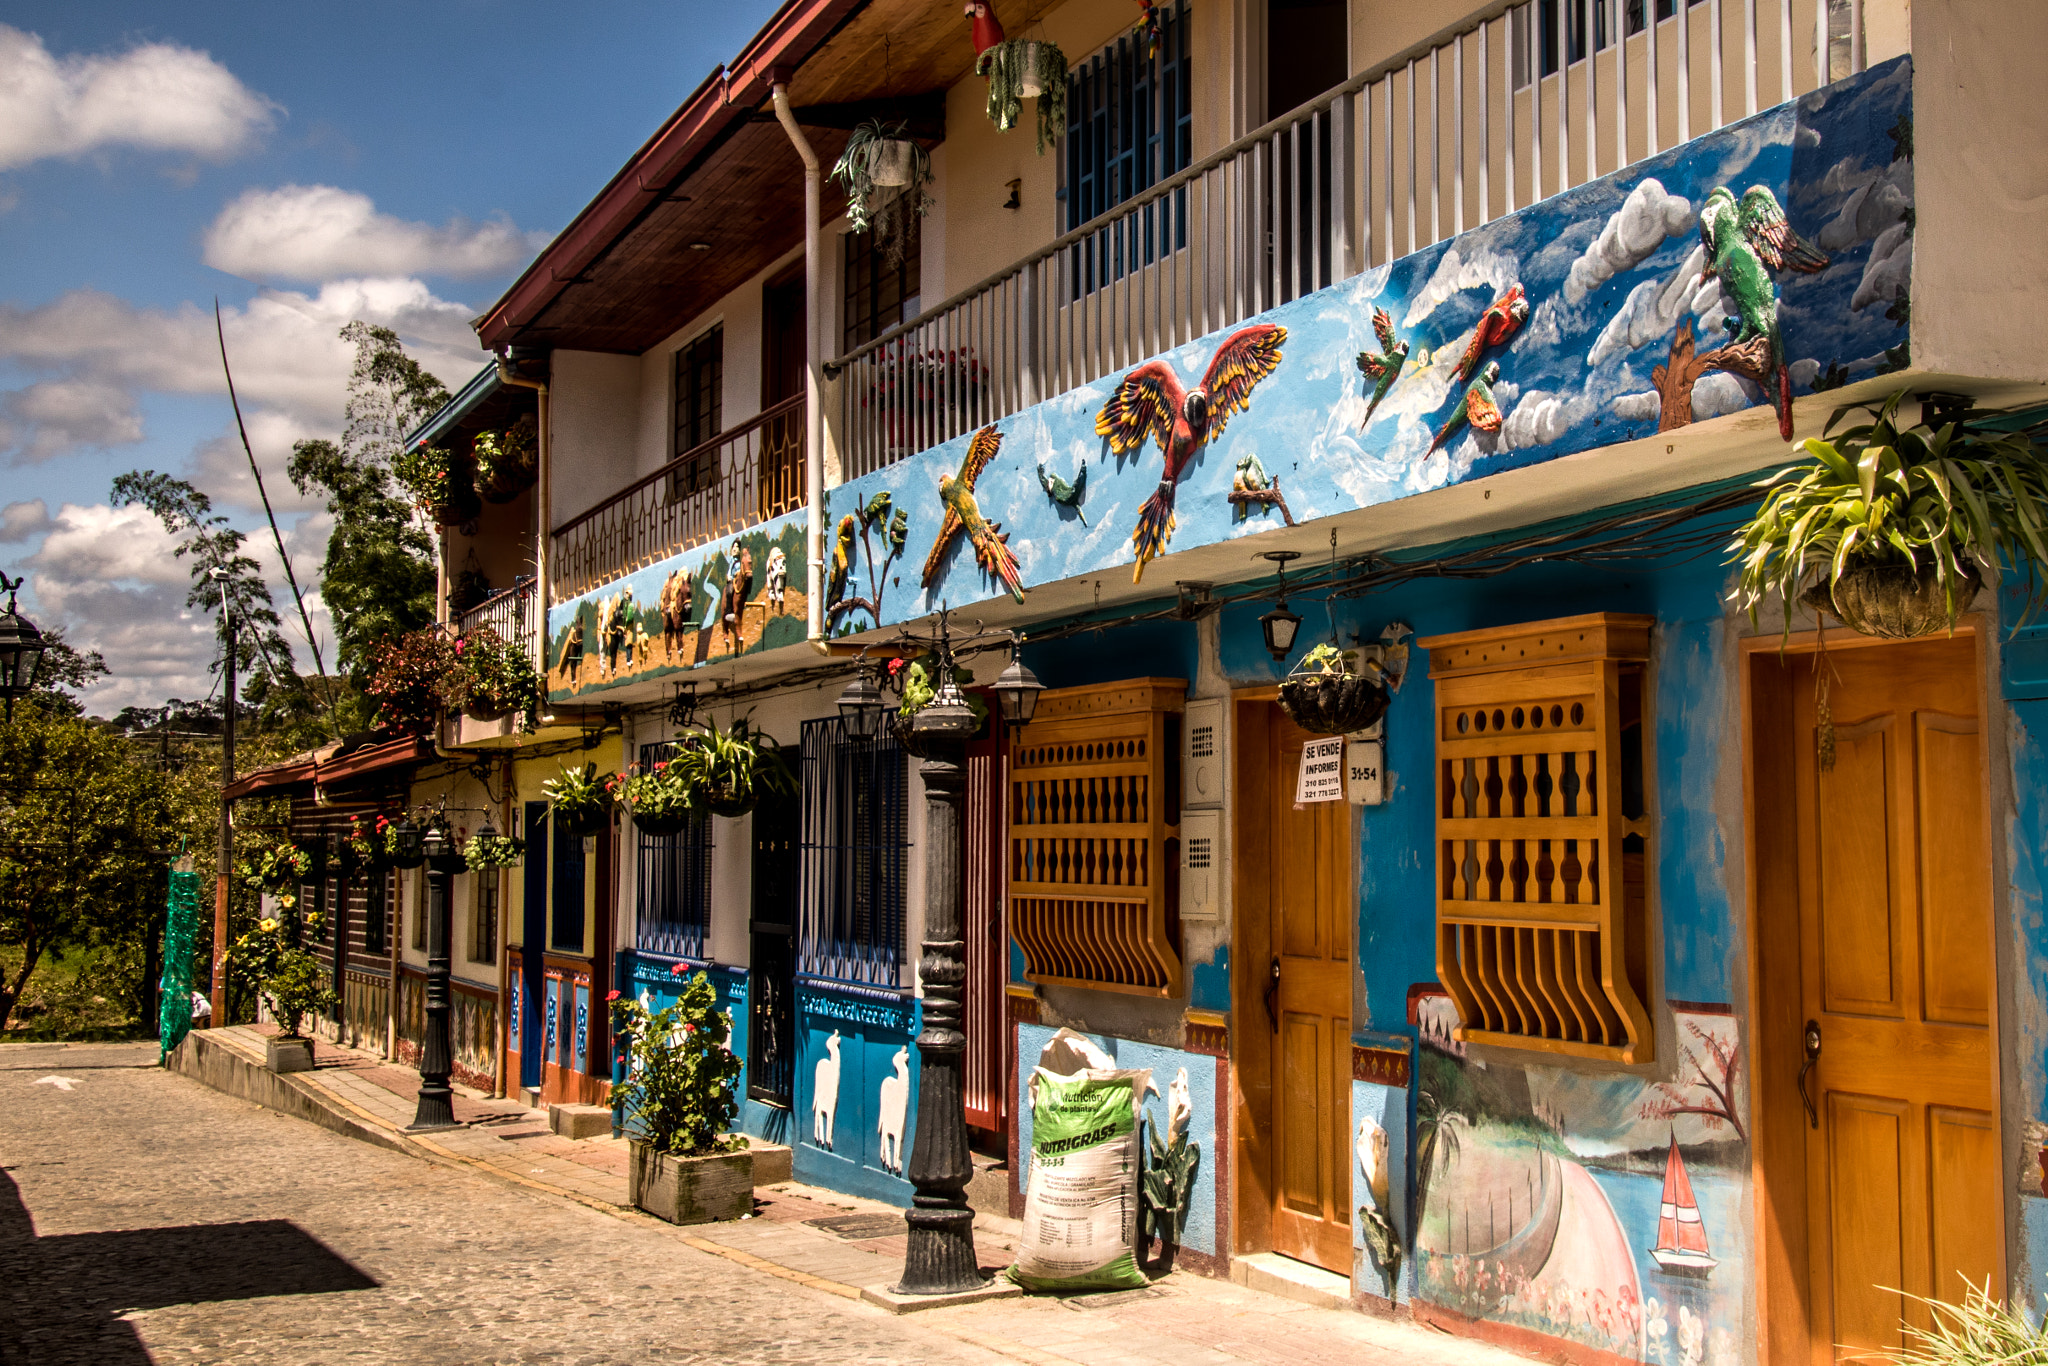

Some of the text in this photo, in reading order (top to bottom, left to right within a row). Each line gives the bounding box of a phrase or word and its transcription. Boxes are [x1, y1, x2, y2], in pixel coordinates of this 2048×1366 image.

[1306, 742, 1340, 759] SE VENDE
[1306, 761, 1338, 775] INFORMES
[1351, 767, 1376, 781] 31-54
[1040, 1122, 1117, 1155] NUTRIGRASS
